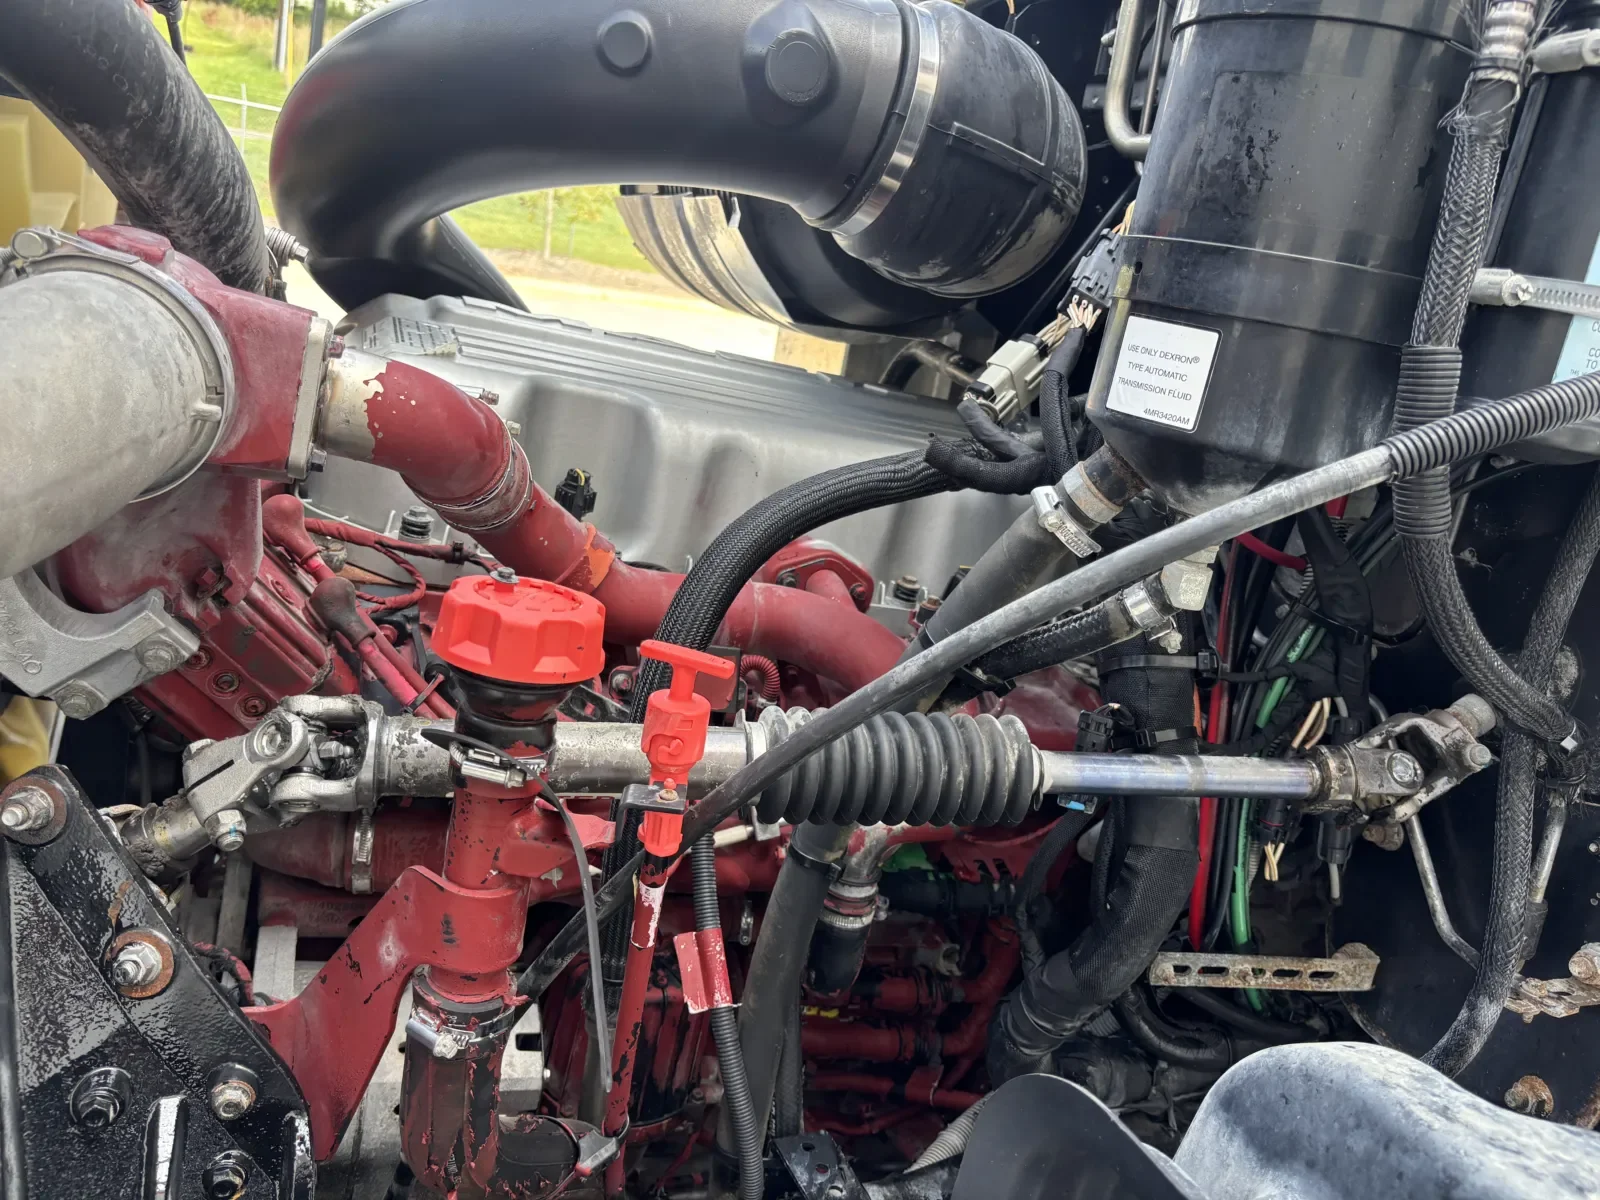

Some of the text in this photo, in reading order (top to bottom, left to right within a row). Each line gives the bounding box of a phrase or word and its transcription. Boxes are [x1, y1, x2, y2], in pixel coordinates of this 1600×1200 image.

[1127, 343, 1140, 353] USE
[1140, 346, 1159, 357] ONLY
[1127, 361, 1188, 382] TYPE AUTOMATIC
[1586, 358, 1598, 370] TO
[1118, 376, 1192, 401] TRANSMISSION FLUID
[1143, 407, 1190, 426] 4MR3420AM
